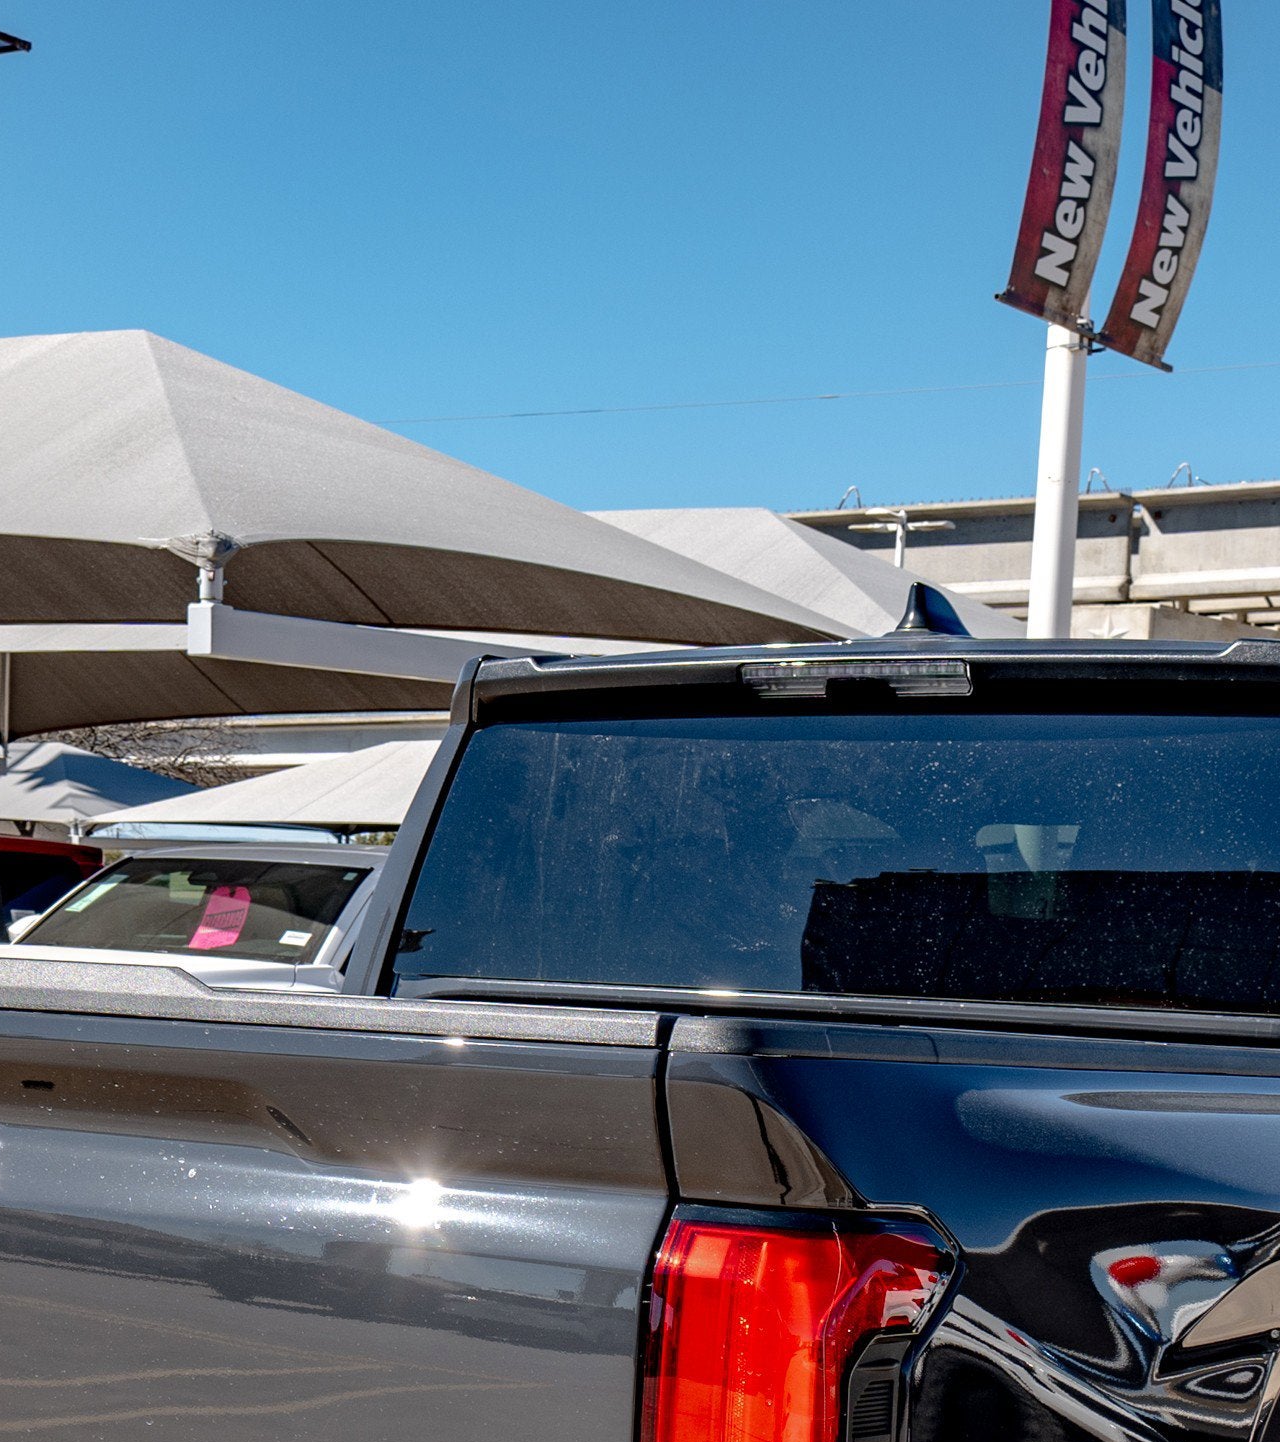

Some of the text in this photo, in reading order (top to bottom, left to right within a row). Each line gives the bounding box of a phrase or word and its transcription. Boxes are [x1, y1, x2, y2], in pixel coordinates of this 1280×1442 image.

[1034, 140, 1096, 288] New
[1129, 0, 1204, 330] New Vehicl
